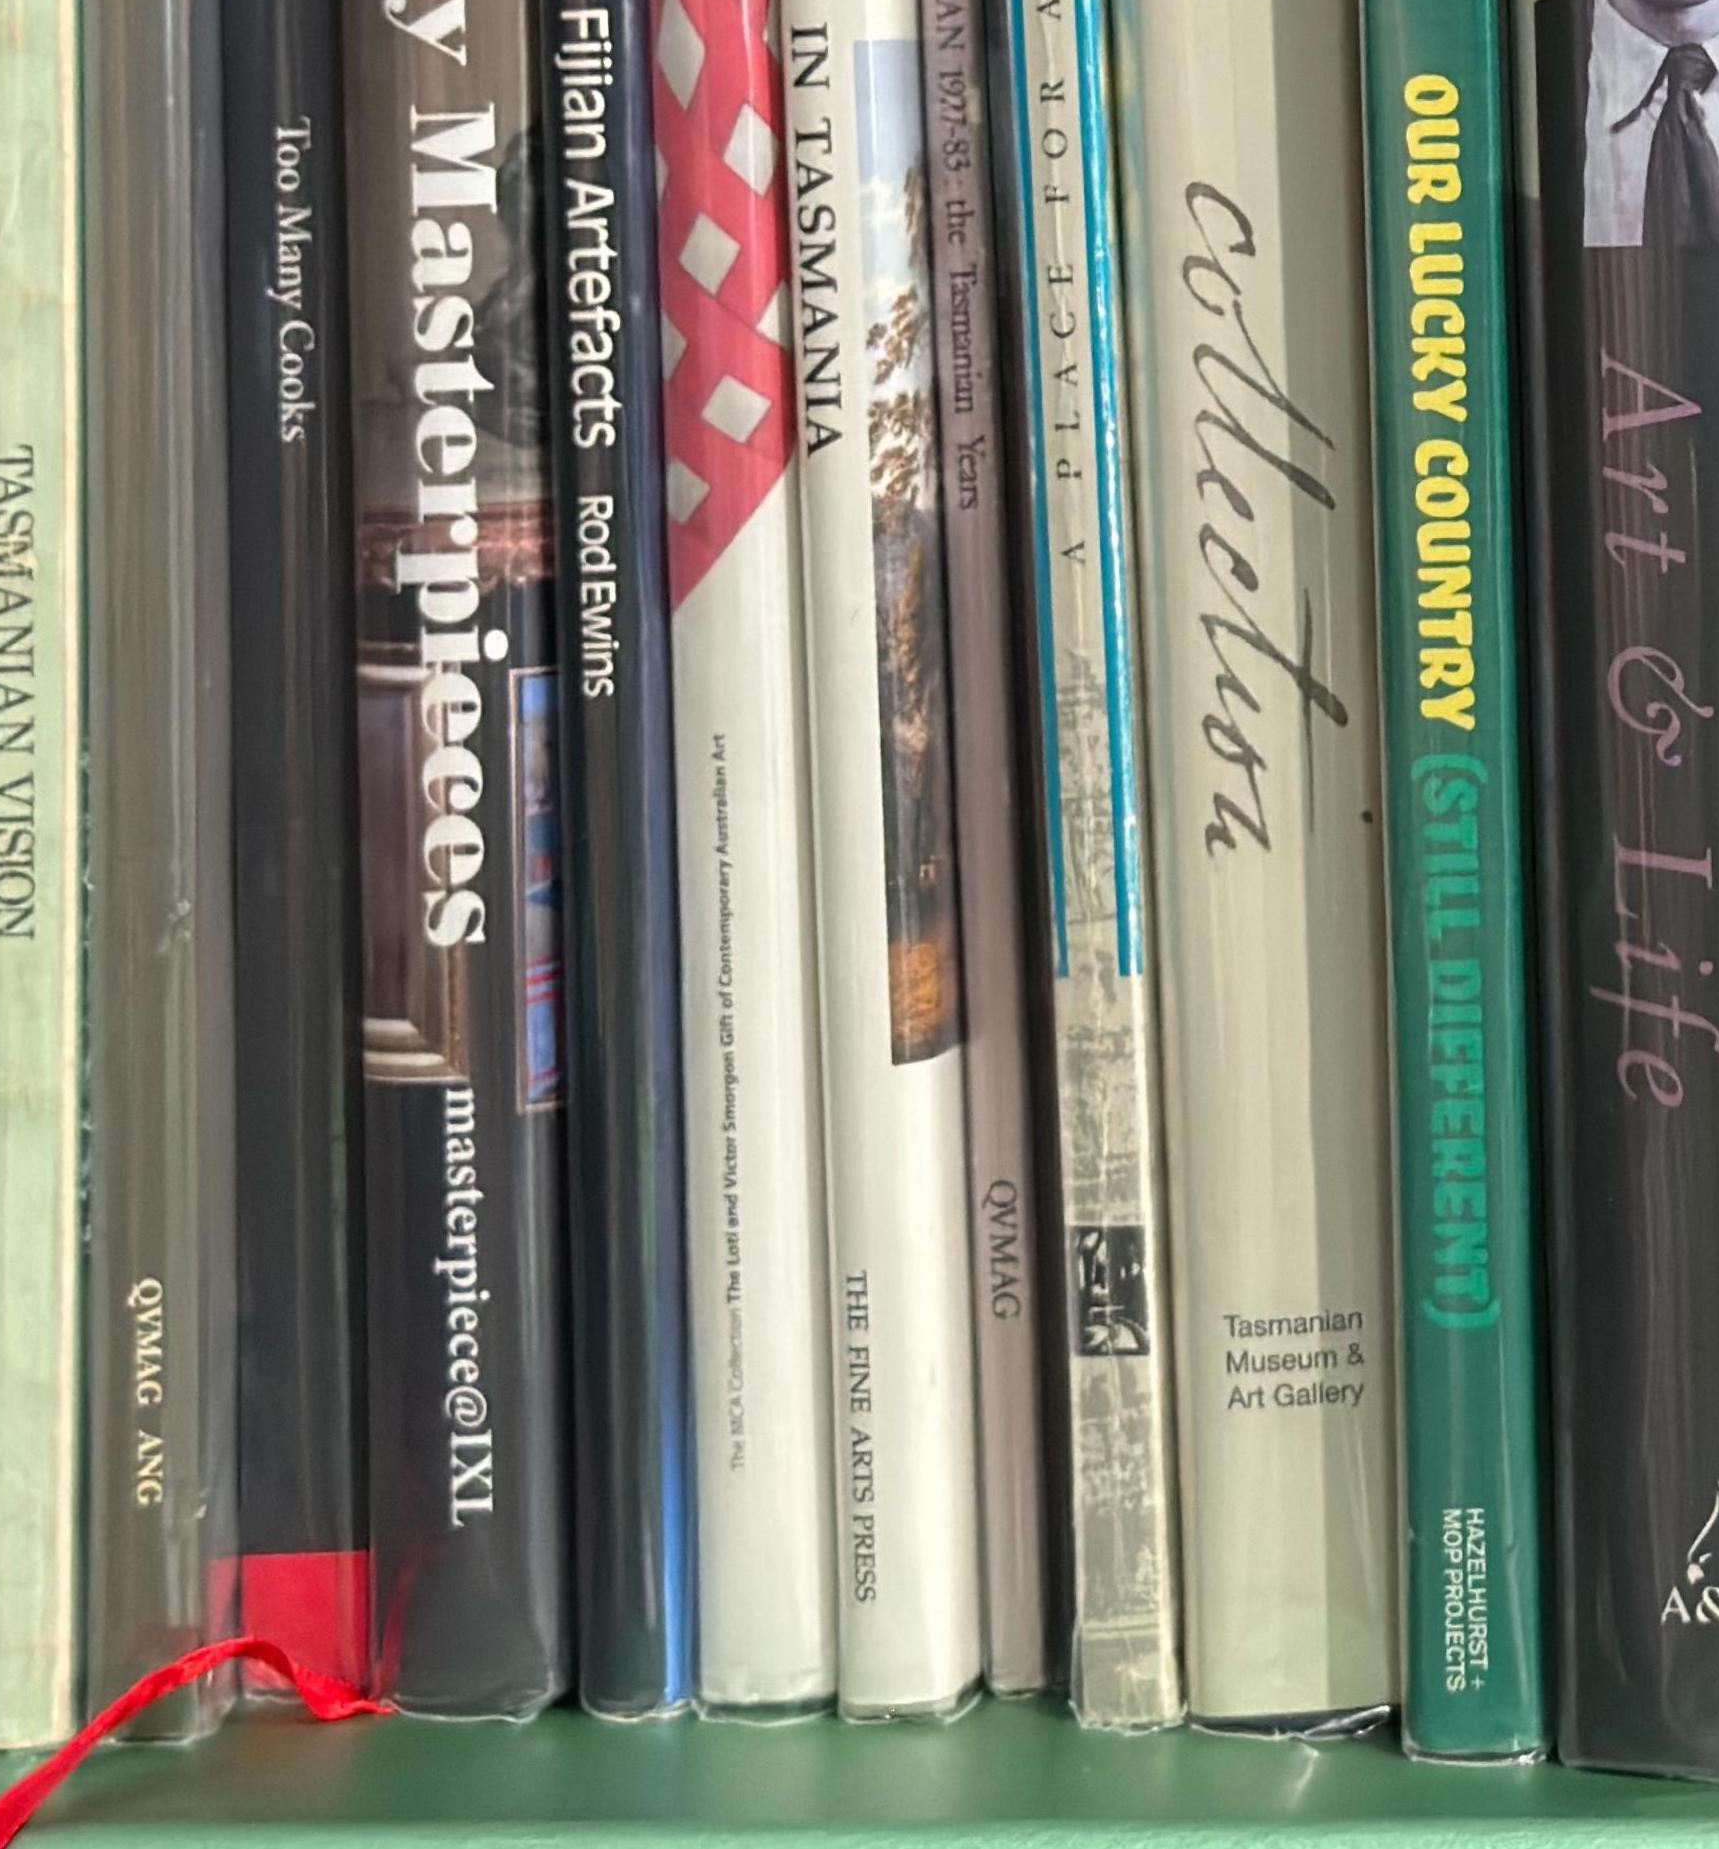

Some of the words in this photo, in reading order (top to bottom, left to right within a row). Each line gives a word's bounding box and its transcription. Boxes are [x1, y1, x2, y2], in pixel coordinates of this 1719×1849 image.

[555, 6, 612, 158] Fijian
[788, 24, 829, 90] IN
[275, 115, 314, 190] Too
[1405, 73, 1462, 203] OUR
[267, 203, 315, 311] Many
[945, 199, 975, 245] the
[564, 178, 622, 449] Artefacts
[793, 116, 844, 459] TASMANIA
[949, 264, 980, 415] Tasmanian
[1411, 221, 1468, 421] LUCKY
[277, 319, 317, 443] Cooks
[956, 433, 987, 511] Years
[1182, 179, 1375, 858] collection
[1597, 348, 1703, 578] Art
[395, 102, 510, 951] Masterpieces
[579, 493, 617, 573] Rod
[1416, 436, 1476, 731] COUNTRY
[580, 579, 620, 699] Ewins
[1426, 968, 1503, 1333] DIFFERENT)
[435, 1087, 495, 1527] masterpiece@IXL
[845, 1269, 870, 1331] THE
[982, 1179, 1023, 1320] QVMAG
[127, 1278, 165, 1405] QVMAG
[847, 1344, 873, 1413] FINE
[1222, 1310, 1364, 1339] Tasmanian
[1226, 1347, 1339, 1375] Museum
[1227, 1385, 1266, 1410] Art
[1272, 1381, 1366, 1409] Gallery
[133, 1429, 166, 1505] ANG
[849, 1423, 876, 1503] ARTS
[851, 1512, 879, 1601] PRESS
[1444, 1508, 1463, 1564] MOP
[1466, 1507, 1488, 1671] HAZELHURST
[1444, 1568, 1467, 1693] PROJECTS
